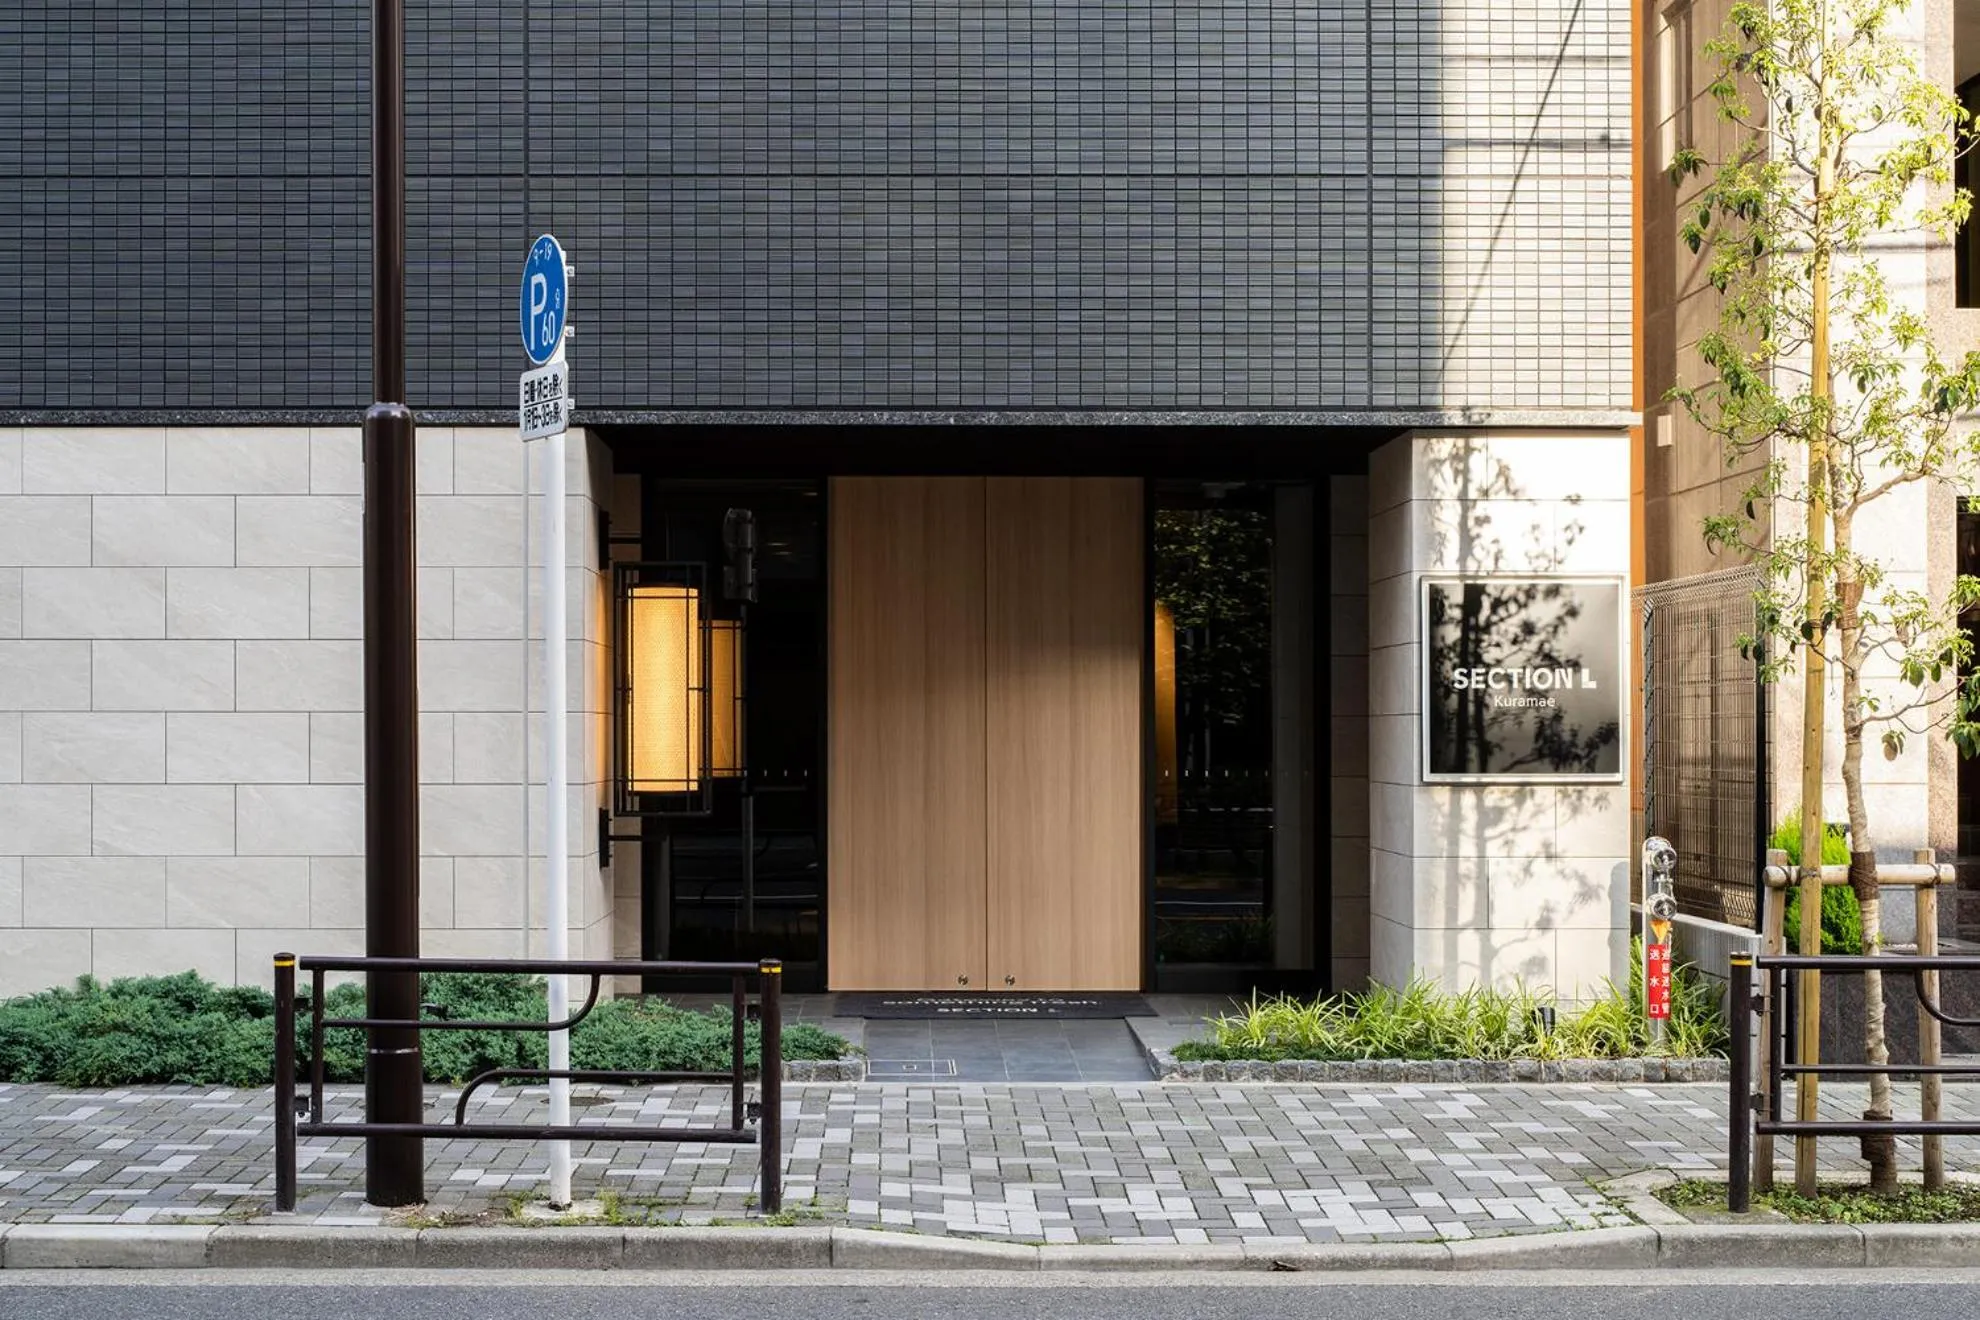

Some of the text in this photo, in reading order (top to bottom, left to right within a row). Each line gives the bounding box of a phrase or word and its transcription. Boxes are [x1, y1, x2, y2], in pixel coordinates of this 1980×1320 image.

[533, 242, 552, 267] 9-19
[531, 273, 547, 350] P
[542, 311, 555, 346] 60
[1453, 667, 1597, 689] SECTION L
[1494, 696, 1556, 707] Kuramae
[1649, 949, 1660, 1014] 送水口
